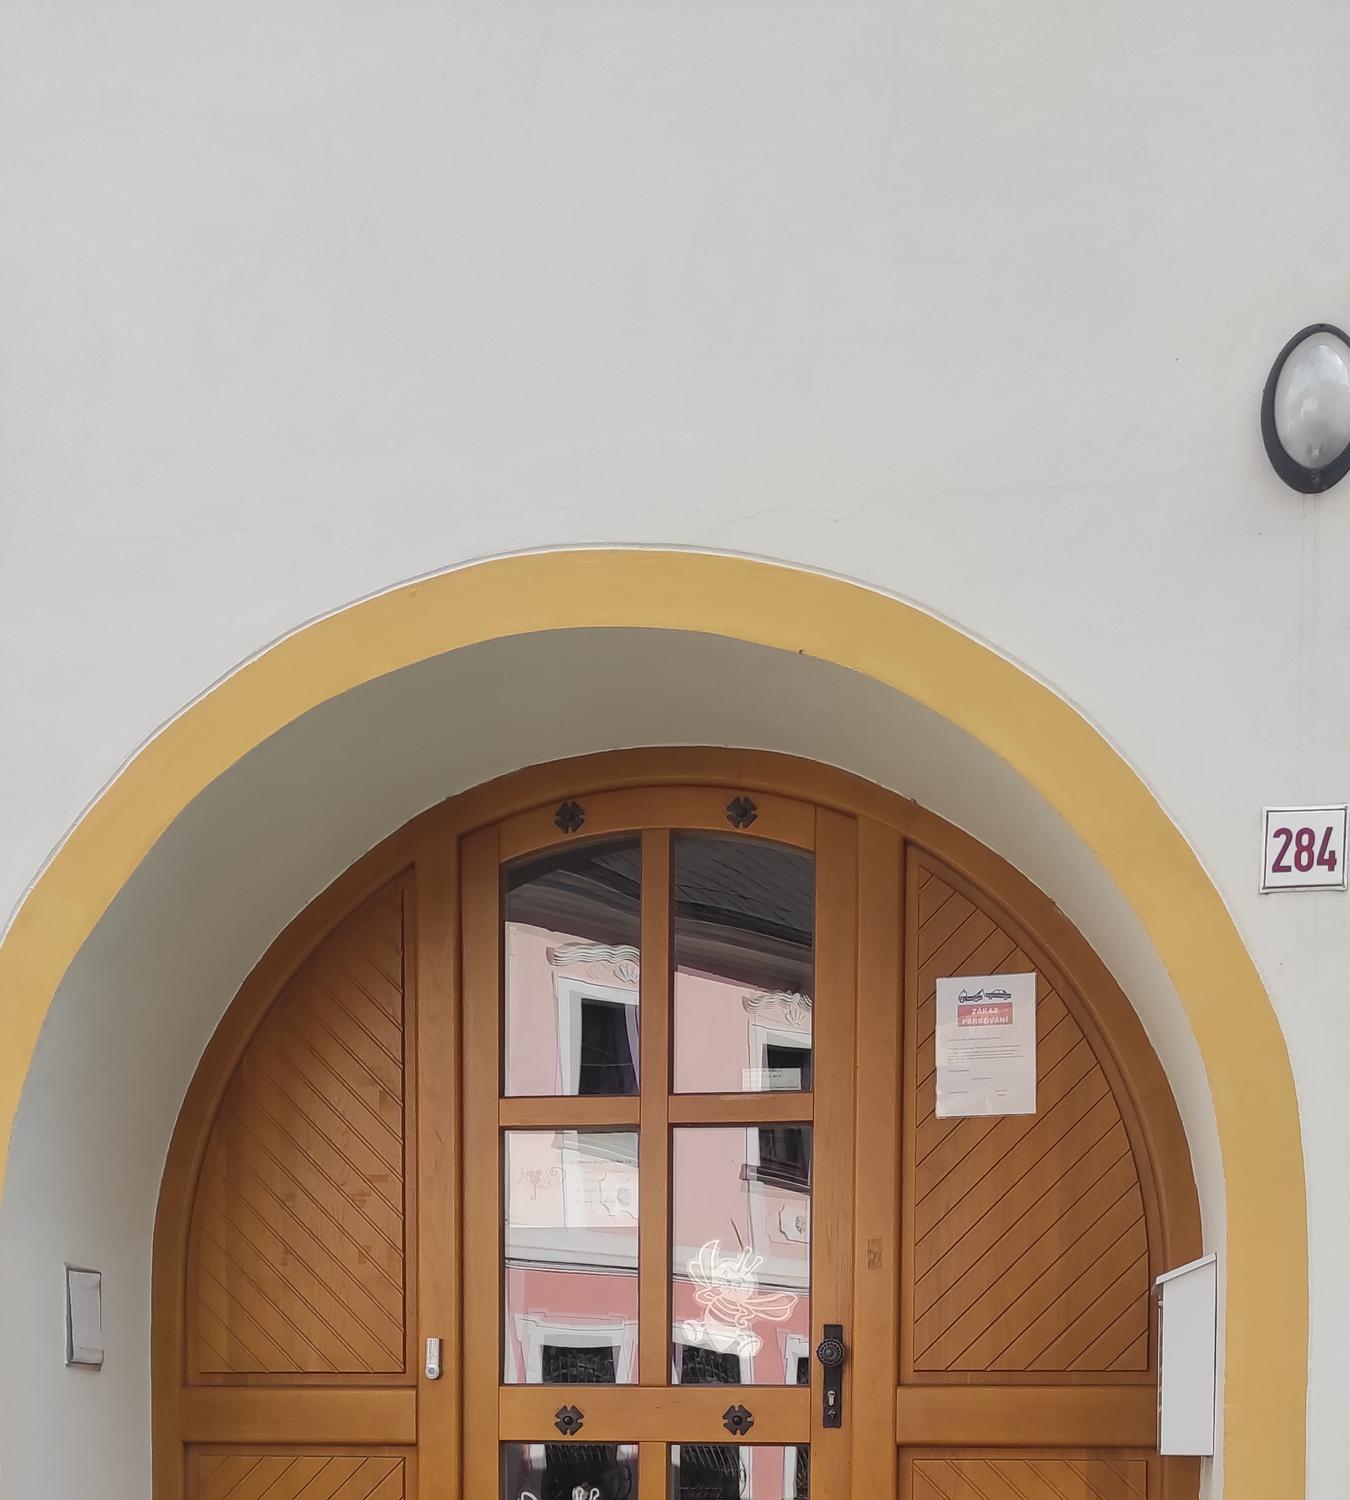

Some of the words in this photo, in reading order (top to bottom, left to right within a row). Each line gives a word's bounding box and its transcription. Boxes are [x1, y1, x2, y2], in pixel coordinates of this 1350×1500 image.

[1272, 826, 1337, 873] 284
[971, 1006, 999, 1015] ZÁKAZ
[962, 1015, 1009, 1025] PARKOVÁNÍ
